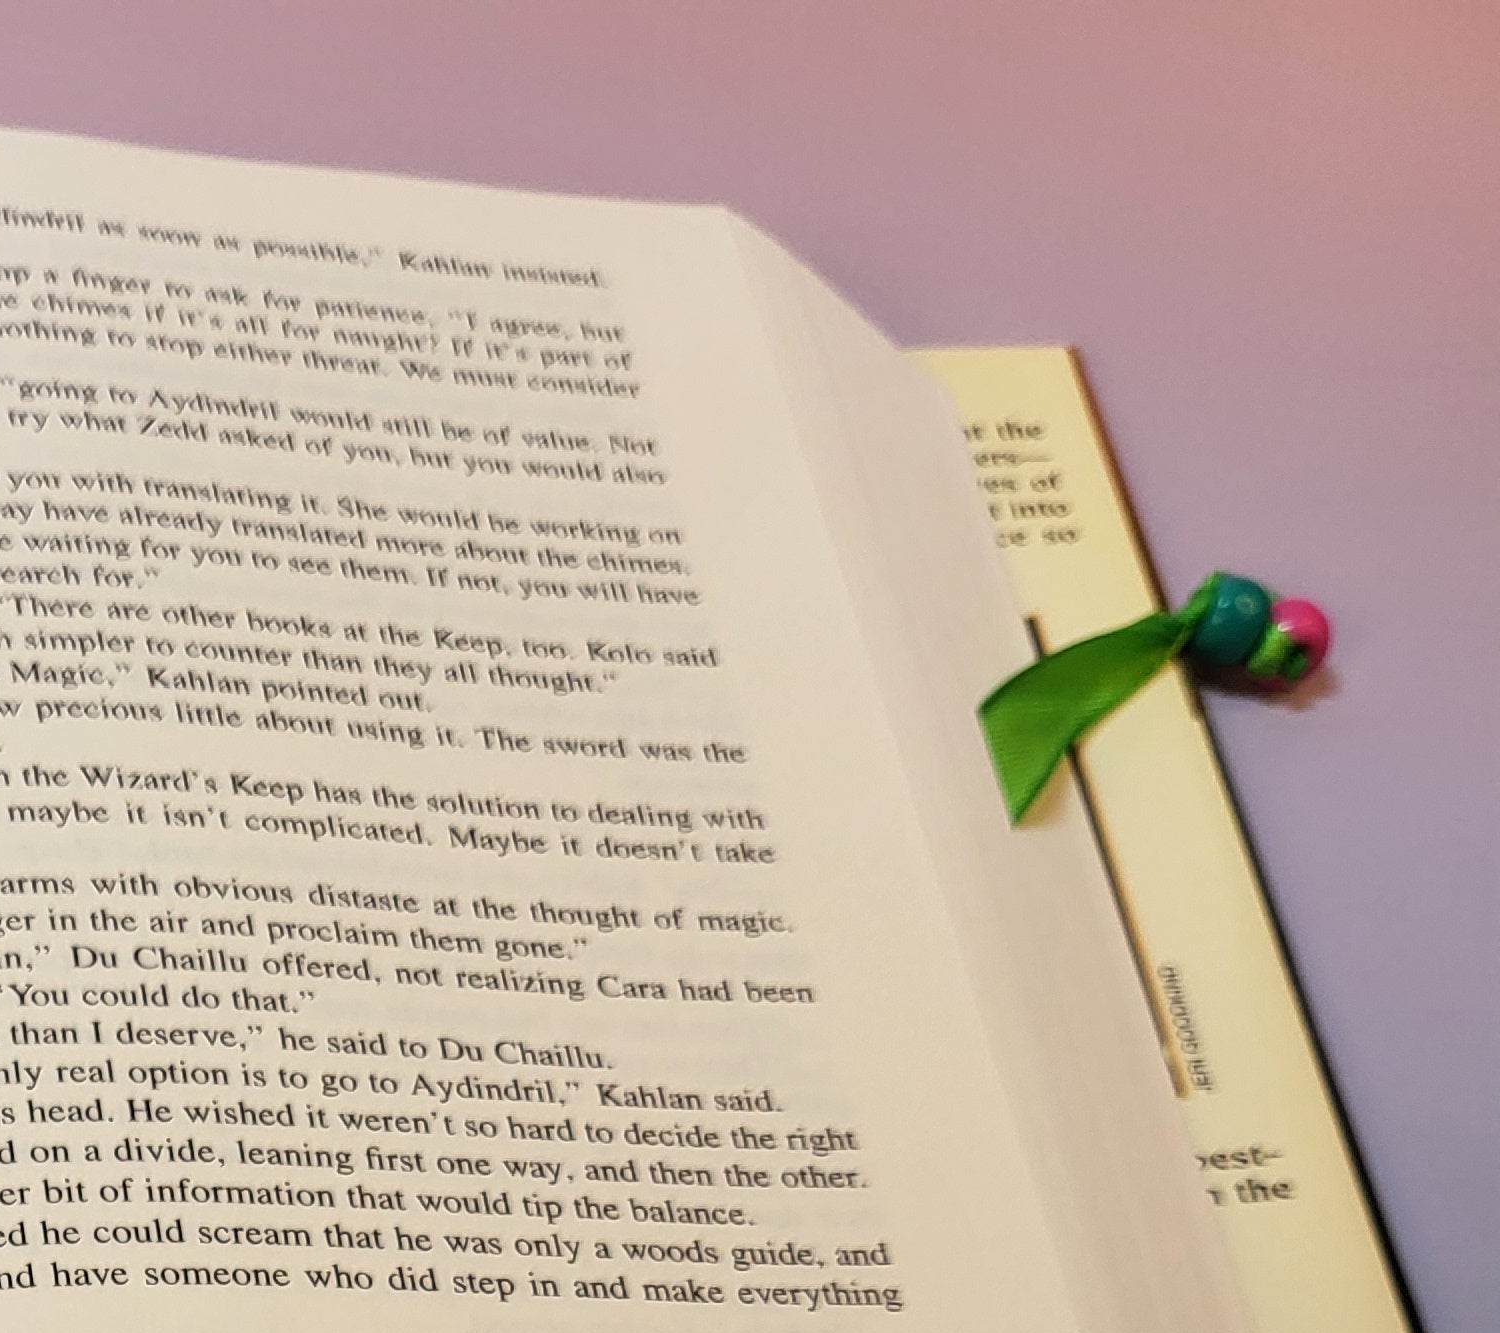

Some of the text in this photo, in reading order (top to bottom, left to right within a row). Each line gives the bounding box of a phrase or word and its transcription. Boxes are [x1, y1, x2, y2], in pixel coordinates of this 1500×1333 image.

[35, 697, 163, 724] precious
[174, 699, 243, 728] little
[255, 709, 335, 737] about
[347, 719, 426, 749] using
[435, 725, 464, 748] it.
[473, 727, 532, 753] The
[543, 737, 627, 759] sword
[639, 743, 692, 761] was
[702, 741, 746, 764] the
[26, 1097, 114, 1124] head.
[126, 1097, 174, 1123] He
[182, 1099, 296, 1127] wished
[305, 1103, 330, 1129] it
[337, 1111, 457, 1136] weren’t
[464, 1119, 499, 1139] so
[505, 1115, 578, 1142] hard
[584, 1123, 615, 1145] to
[623, 1121, 723, 1149] decide
[730, 1126, 778, 1150] the
[785, 1127, 859, 1158] right
[1234, 1176, 1295, 1204] the
